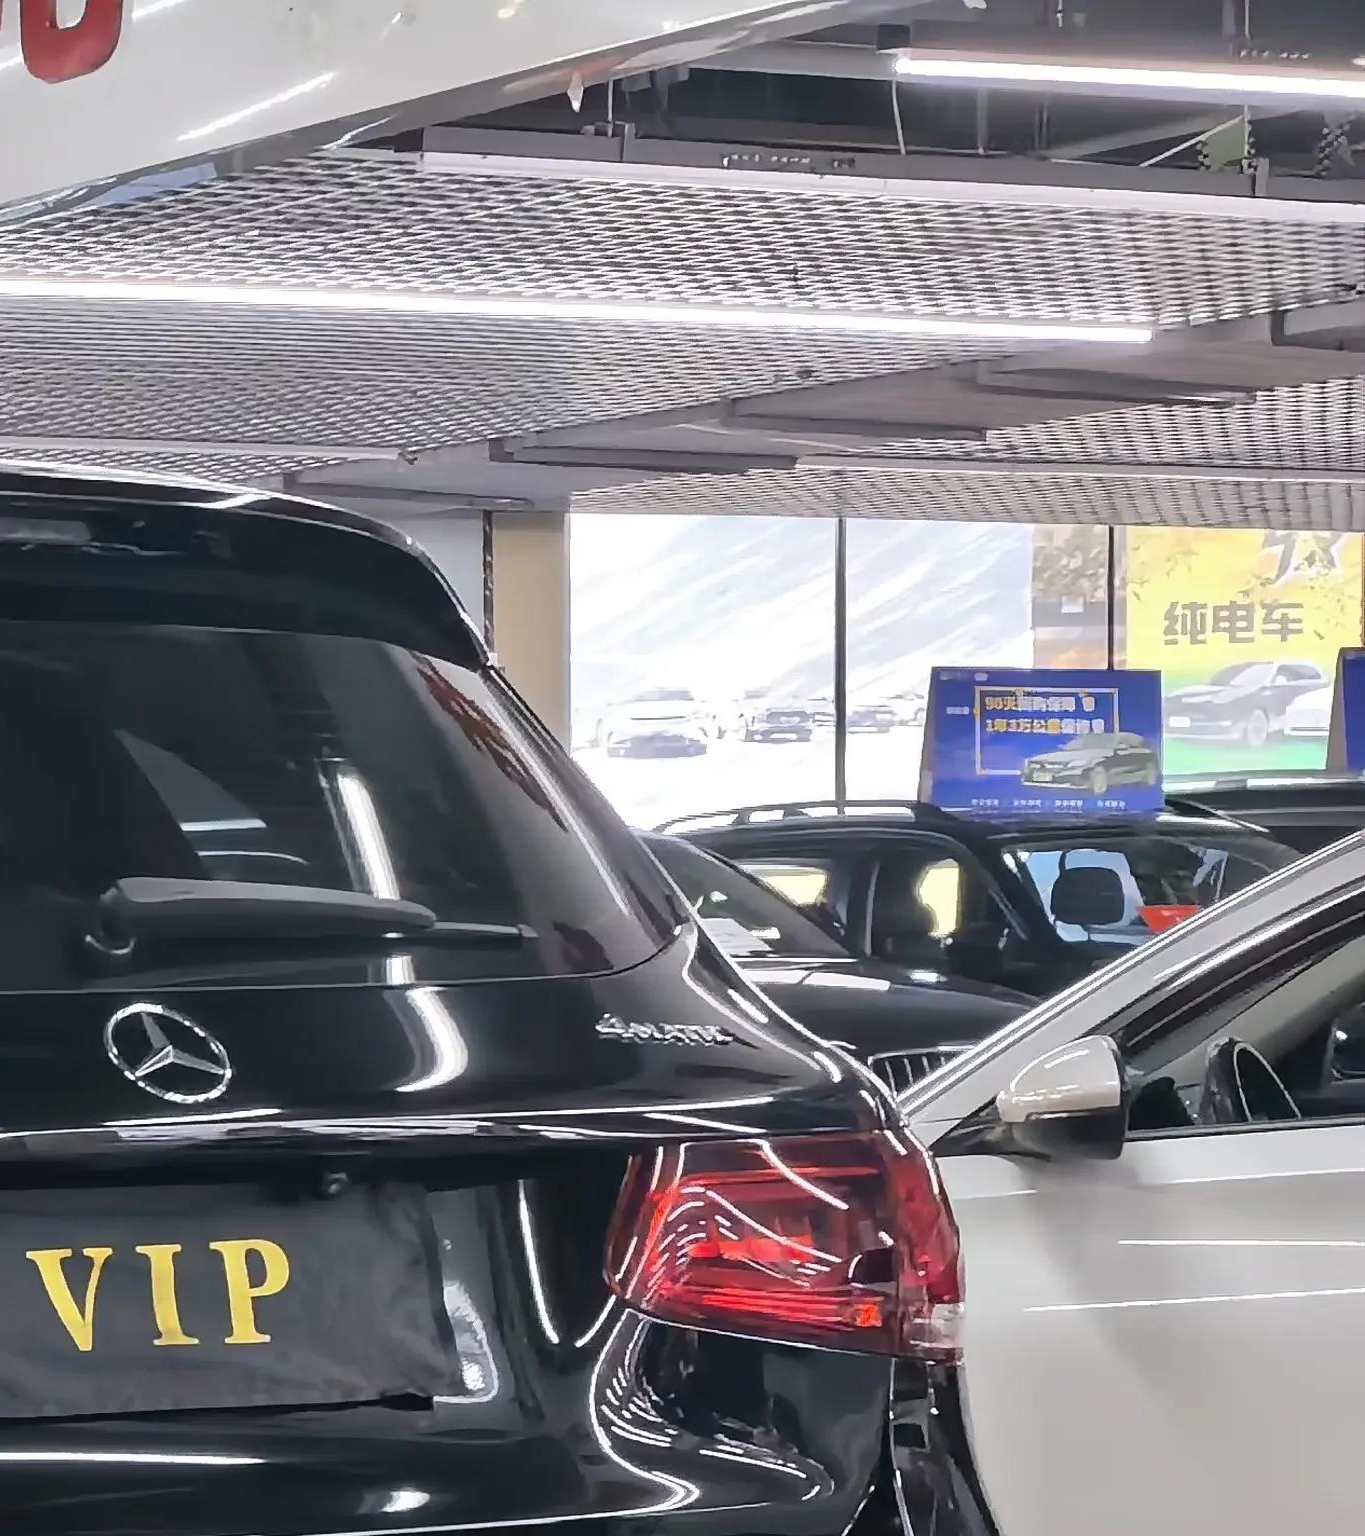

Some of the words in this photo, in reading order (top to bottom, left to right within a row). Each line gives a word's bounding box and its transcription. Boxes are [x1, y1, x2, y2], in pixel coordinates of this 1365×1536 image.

[1163, 600, 1304, 645] 纯电车
[25, 1238, 290, 1352] VIP
